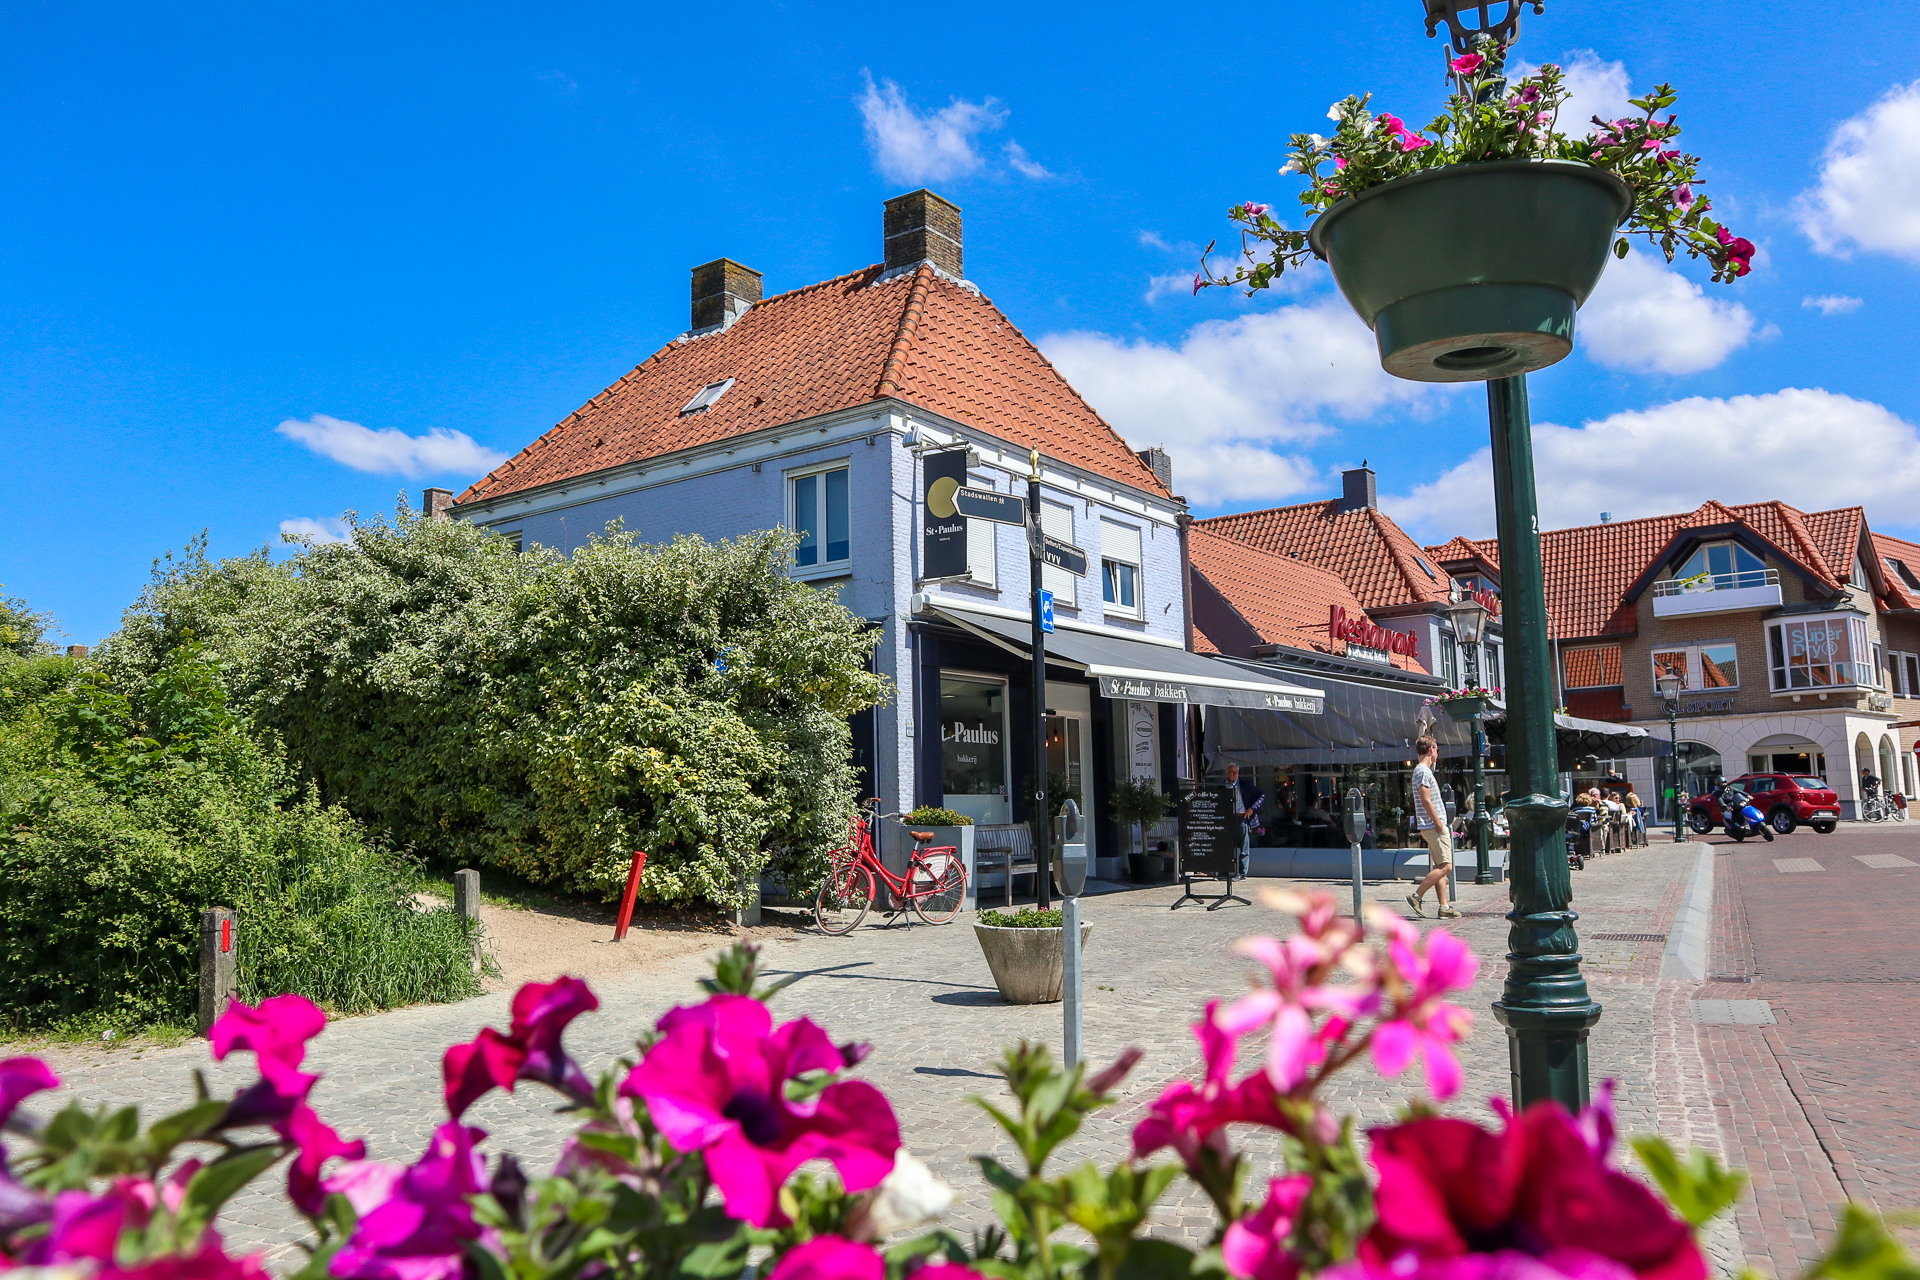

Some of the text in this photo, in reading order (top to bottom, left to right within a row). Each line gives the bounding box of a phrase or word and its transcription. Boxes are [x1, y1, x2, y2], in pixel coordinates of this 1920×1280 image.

[960, 489, 998, 502] Stadswallen
[1046, 551, 1061, 565] VVV
[1329, 604, 1418, 657] Restaurant
[1791, 629, 1842, 645] Super
[1123, 680, 1151, 696] Paulus
[1686, 698, 1734, 713] SPORT
[954, 721, 999, 745] Paulus
[957, 754, 977, 765] bakkerij
